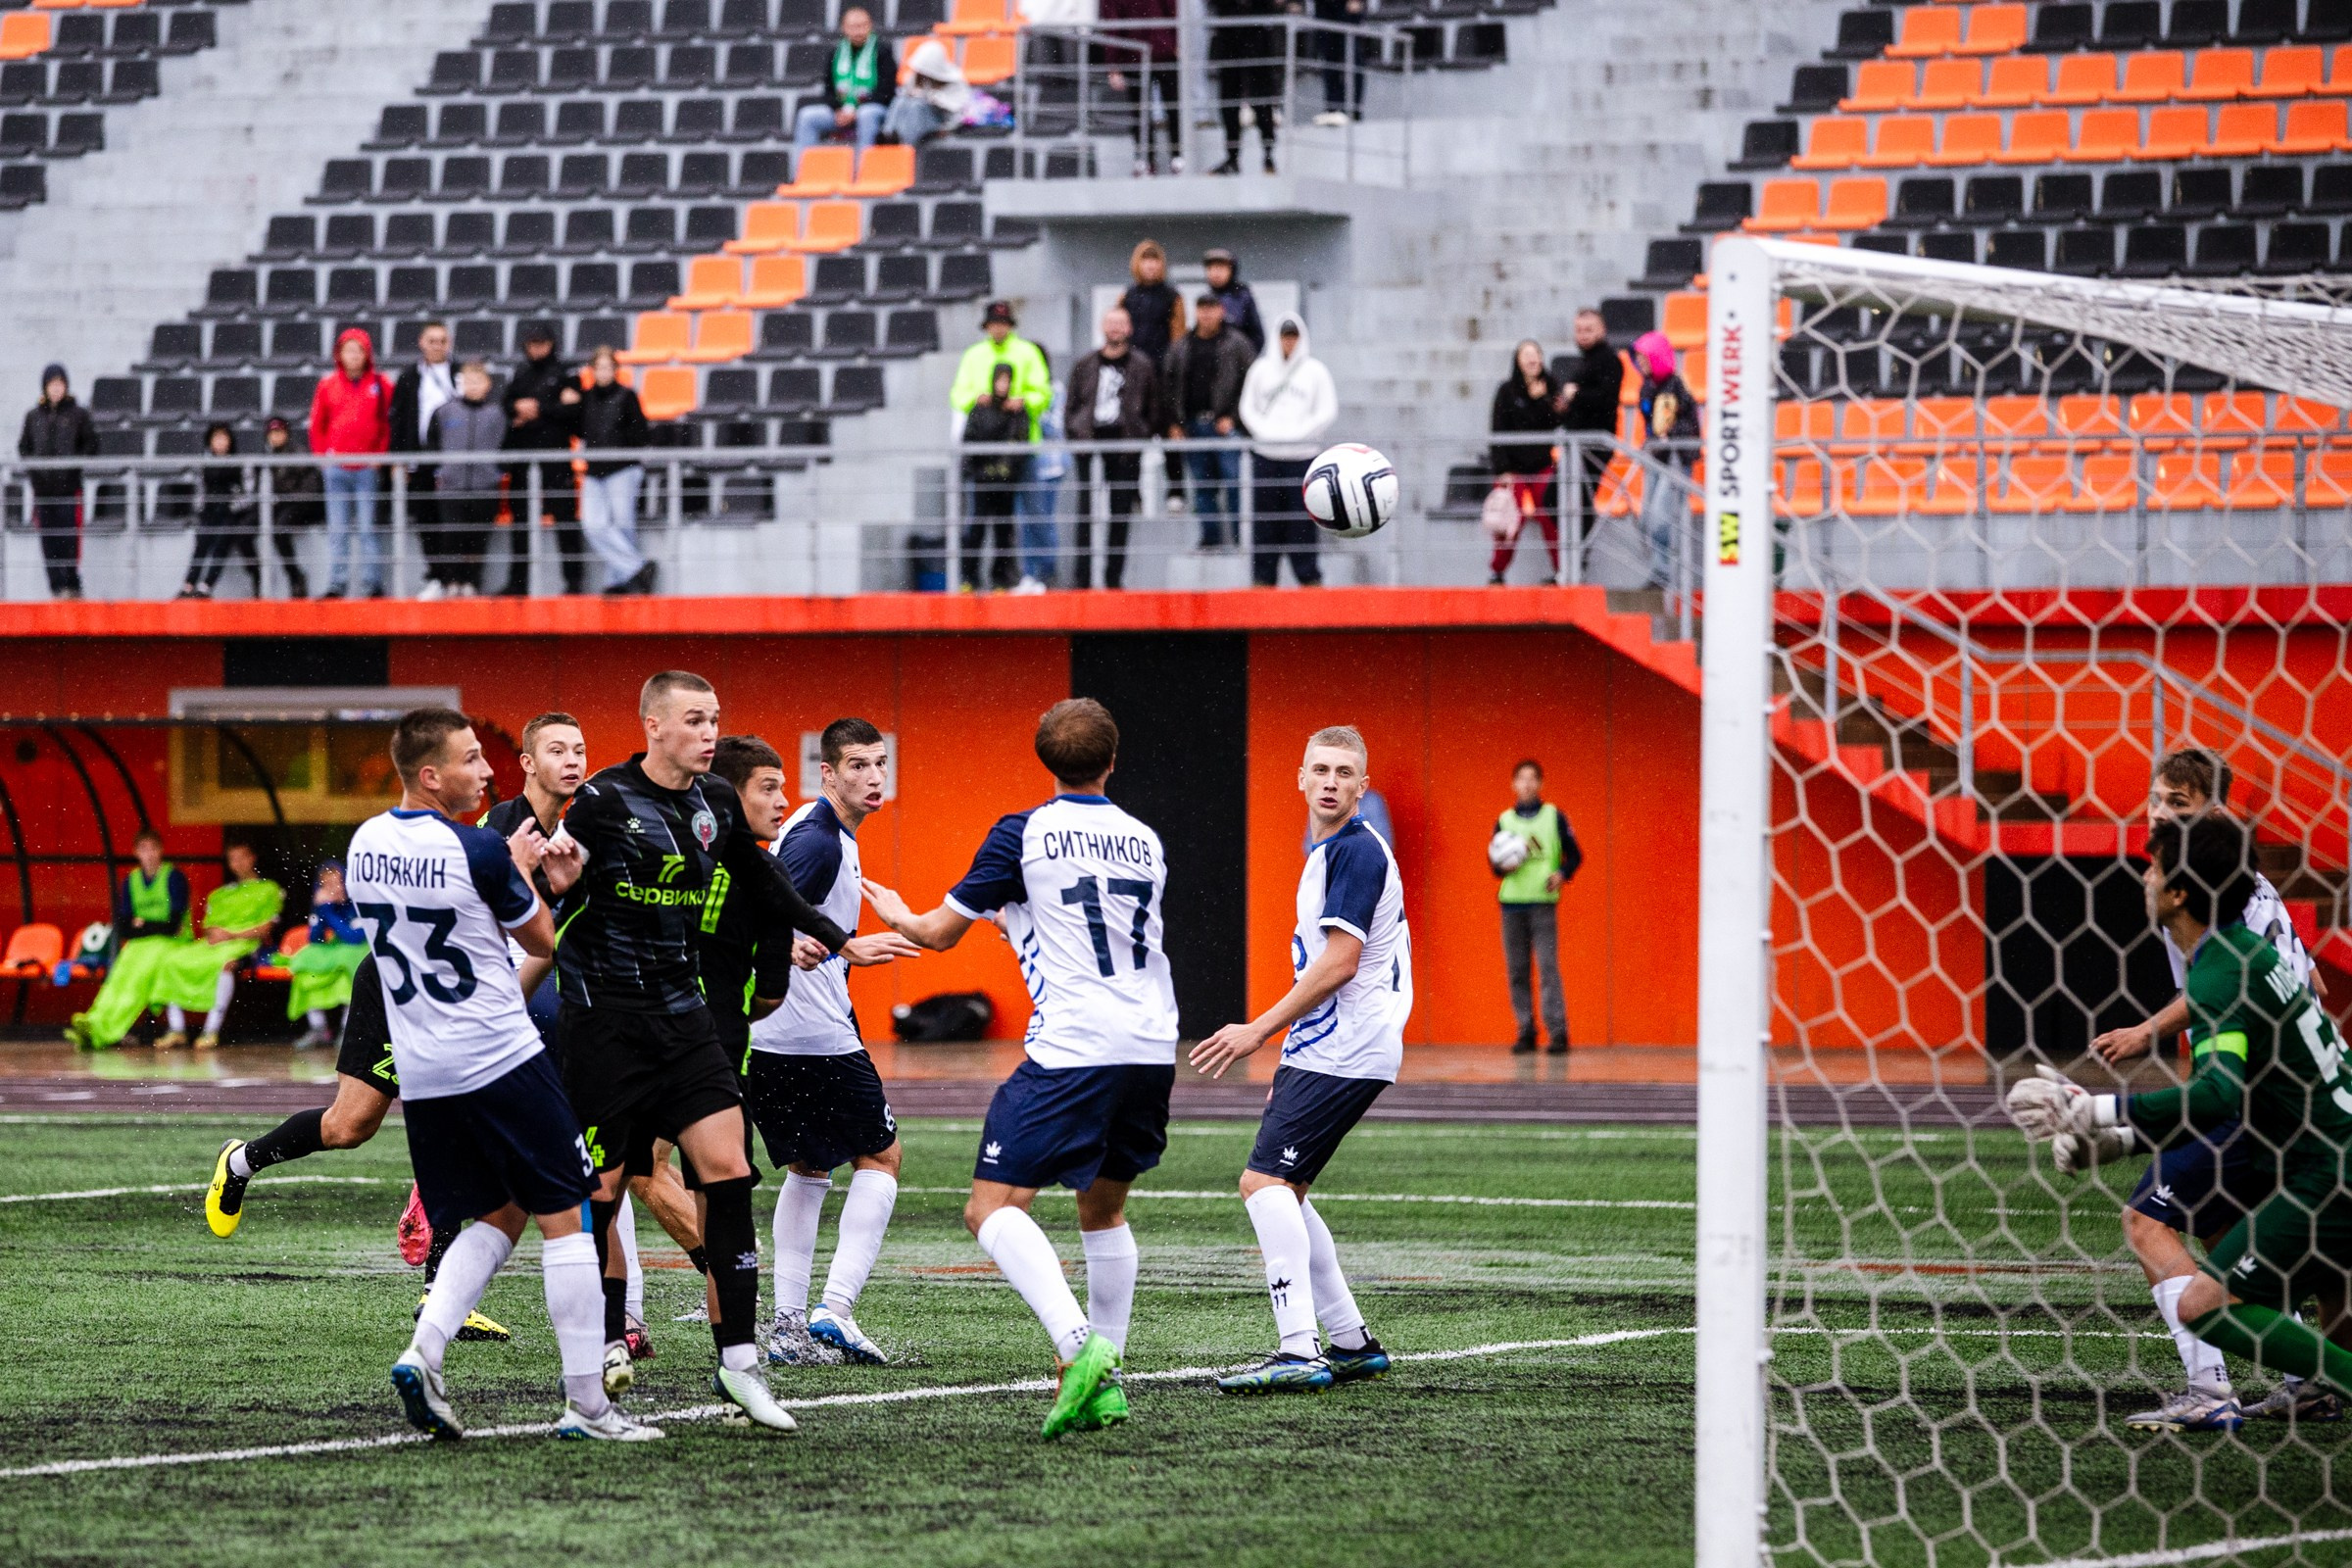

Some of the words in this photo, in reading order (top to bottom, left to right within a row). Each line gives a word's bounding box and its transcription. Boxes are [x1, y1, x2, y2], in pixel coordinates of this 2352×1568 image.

[1719, 324, 1742, 498] SPORTWERK
[352, 852, 446, 889] ПОЛЯКИН
[1044, 830, 1152, 867] СИТНИКОВ
[356, 902, 478, 1006] 33
[1060, 875, 1153, 978] 17
[1273, 1293, 1288, 1309] 11
